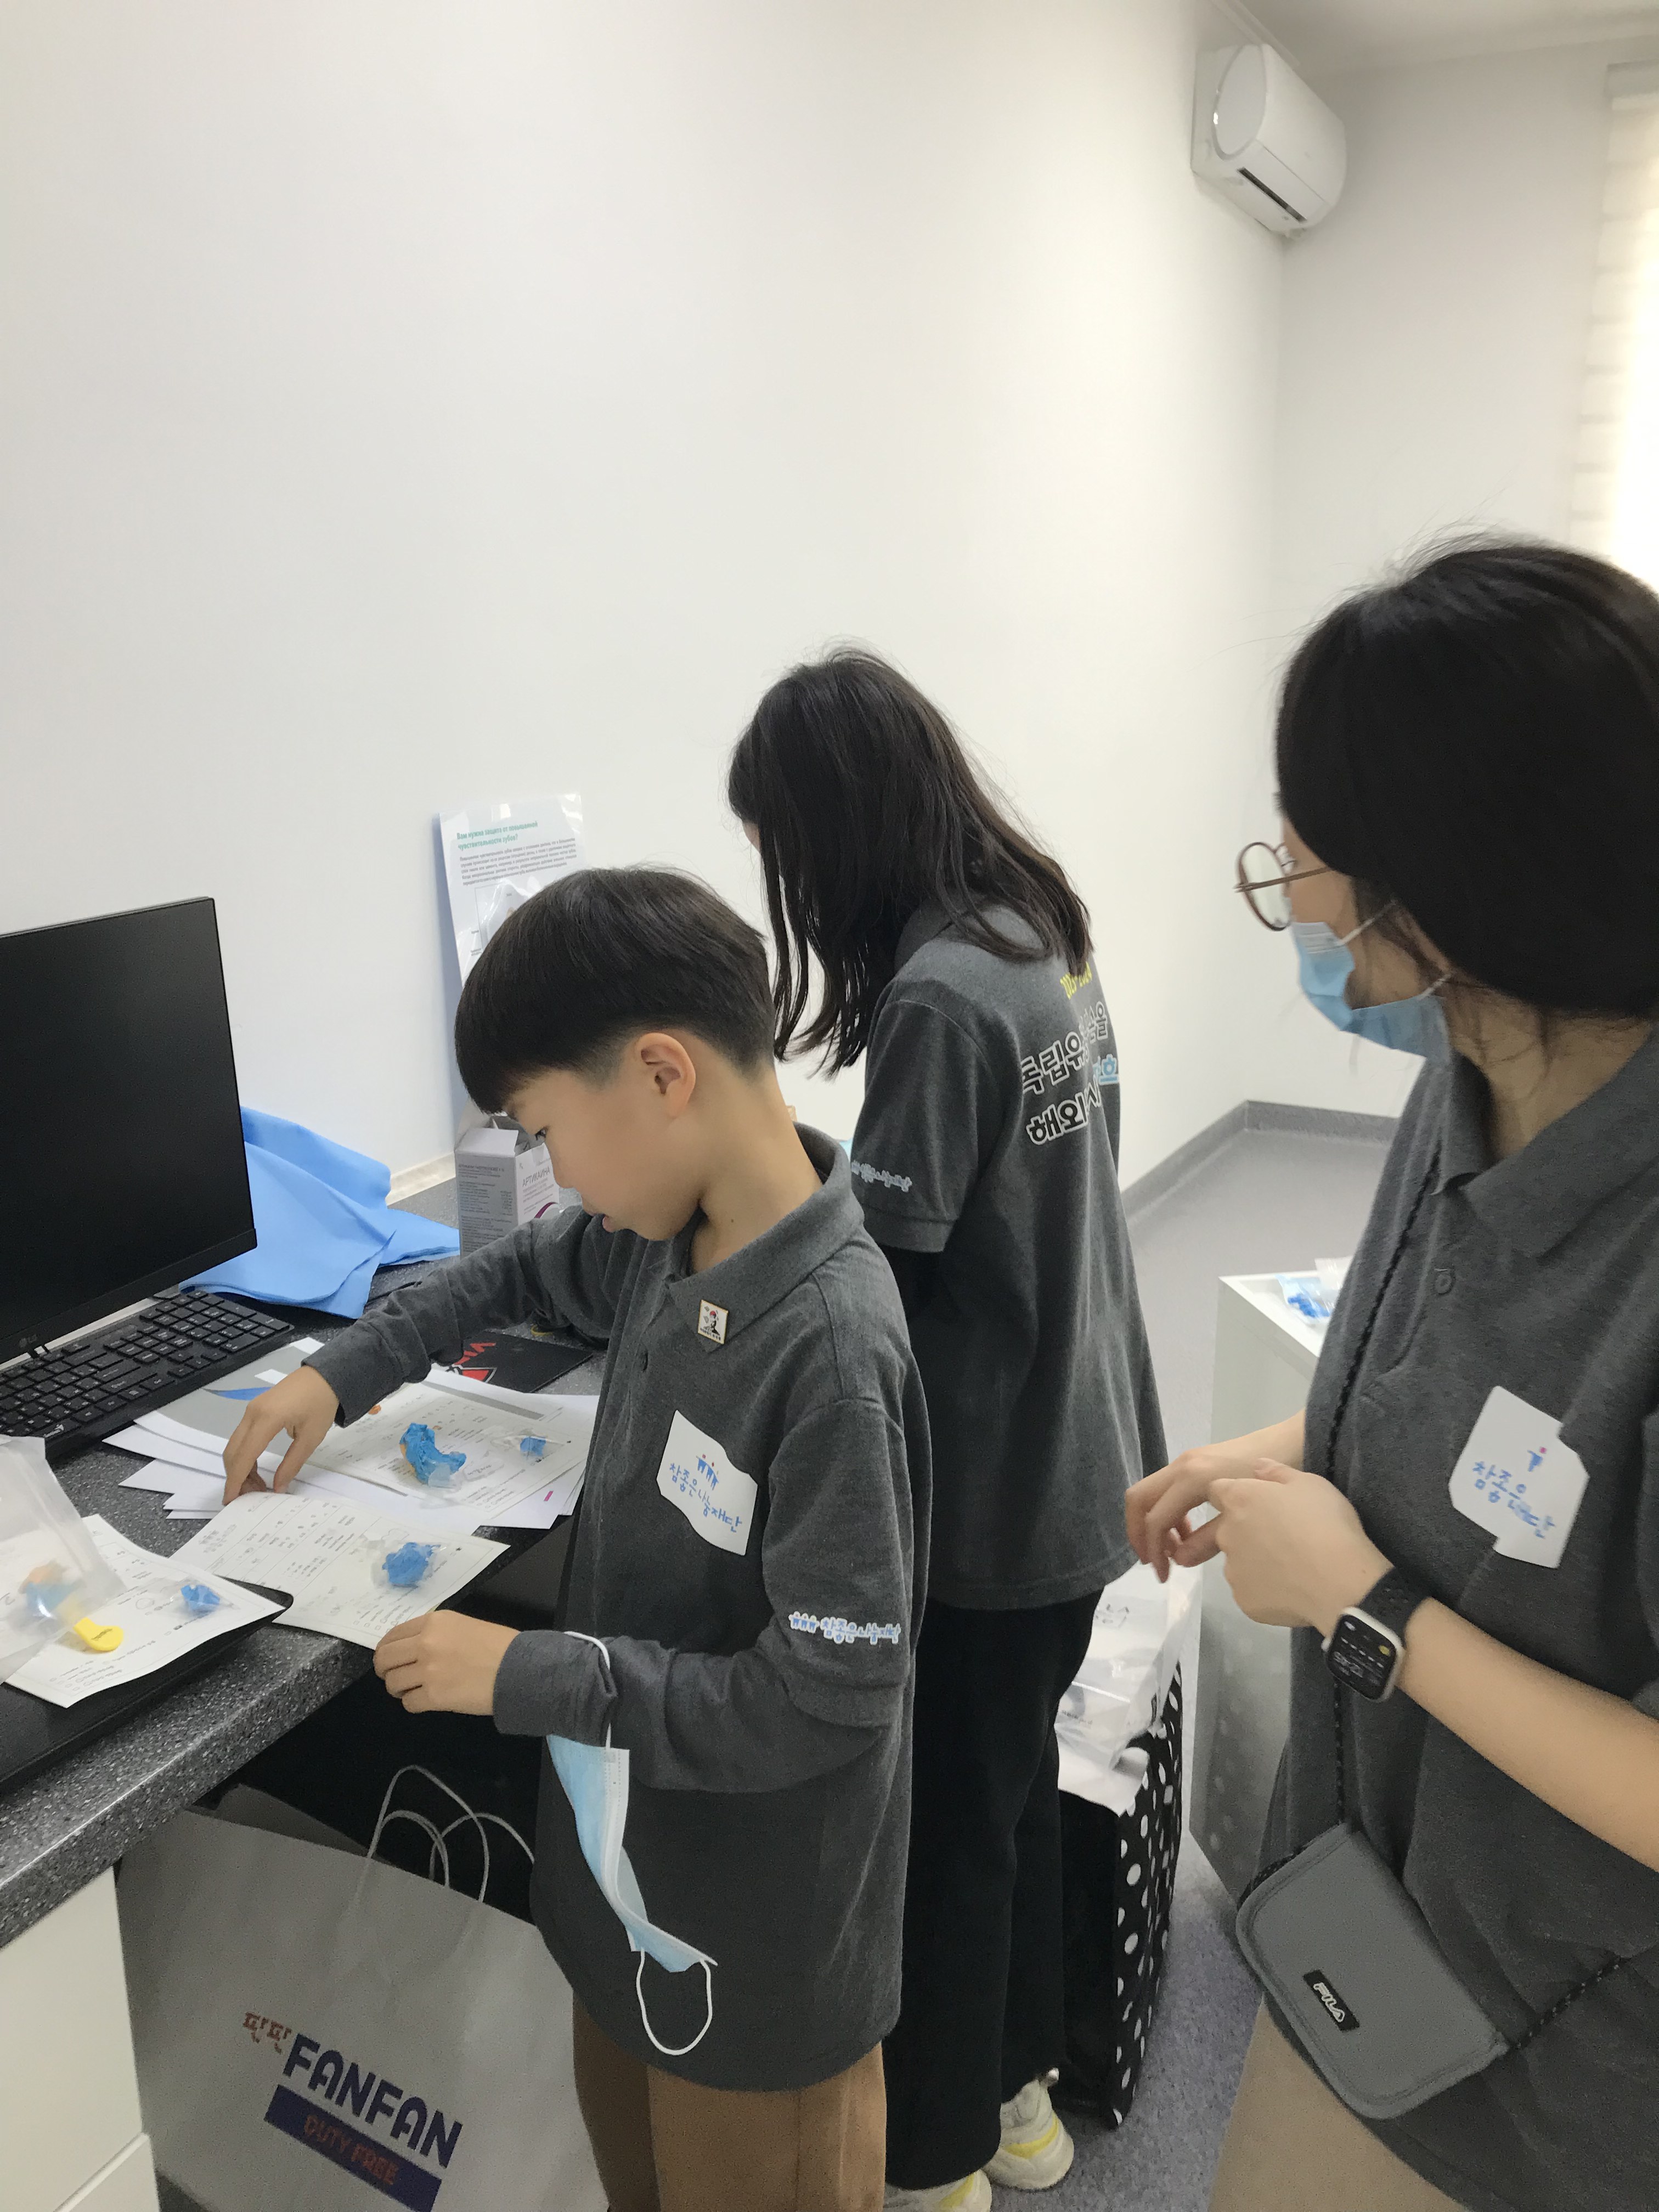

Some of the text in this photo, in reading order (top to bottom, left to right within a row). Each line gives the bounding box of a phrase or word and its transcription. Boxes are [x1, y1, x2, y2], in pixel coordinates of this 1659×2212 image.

[283, 2033, 463, 2169] FANFAN
[304, 2114, 399, 2185] DUTY FREE
